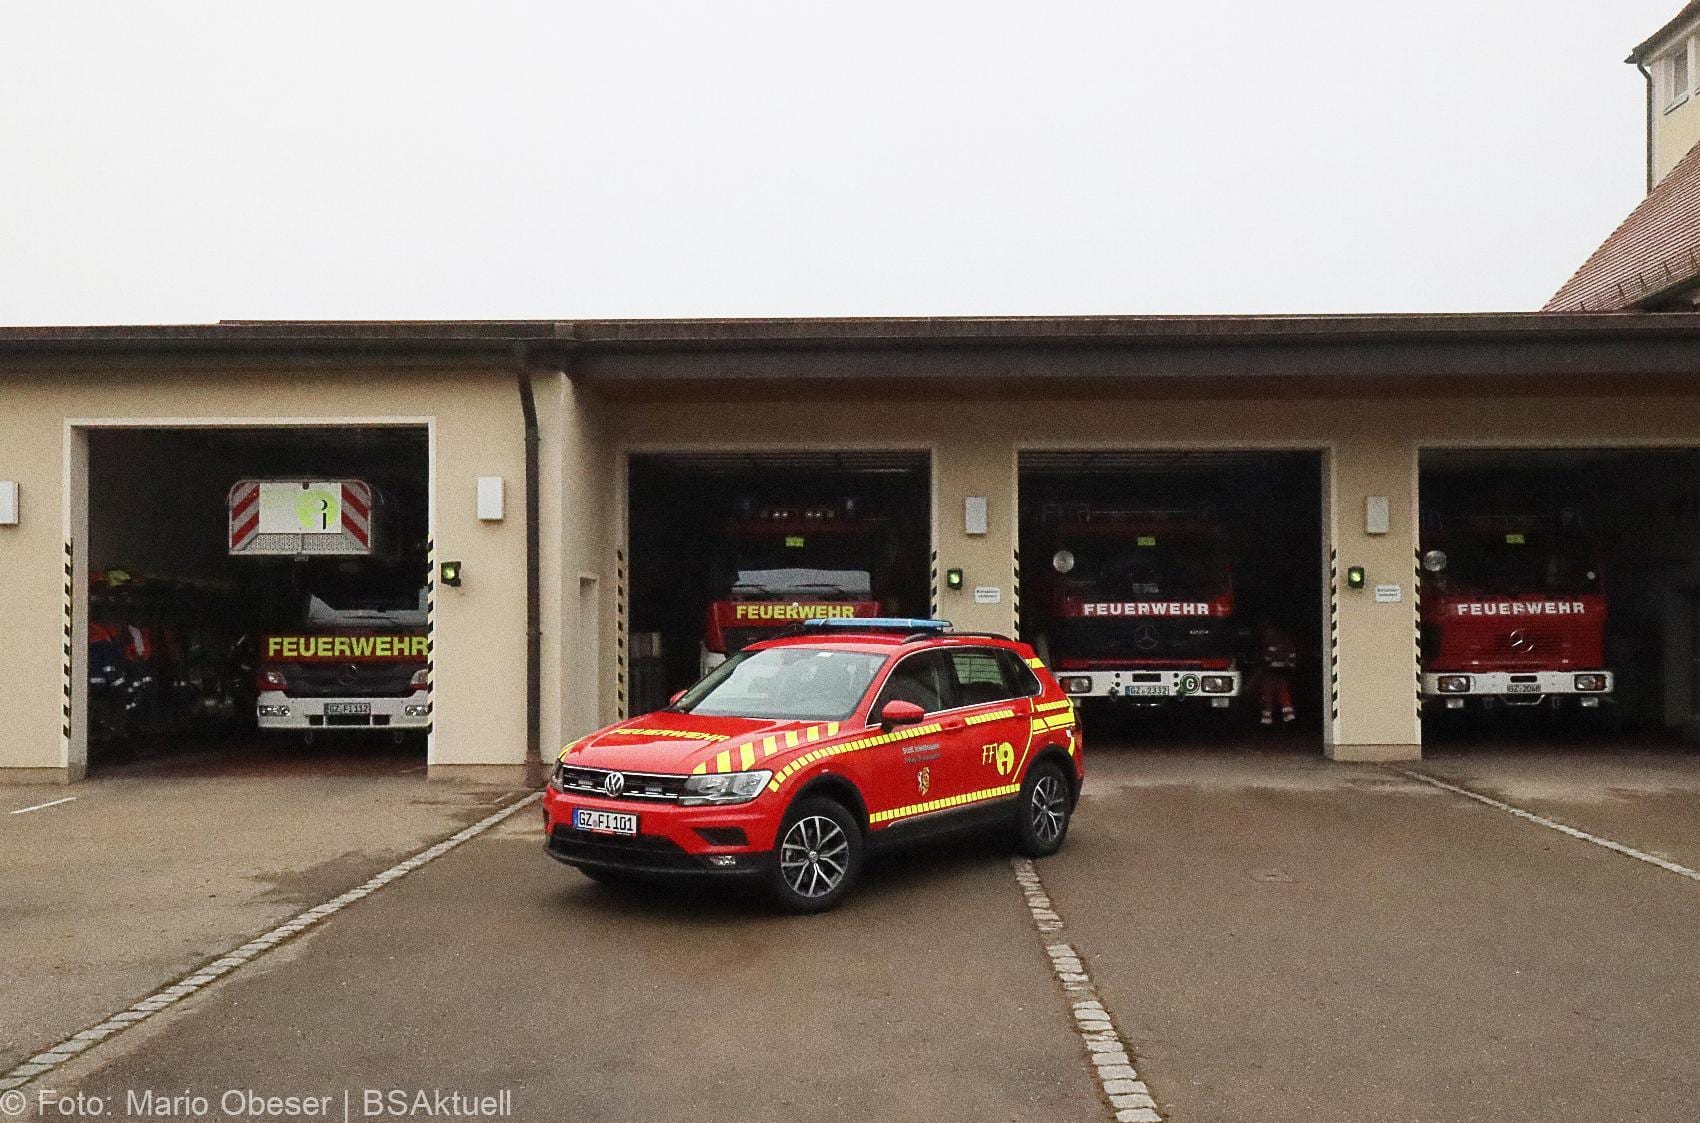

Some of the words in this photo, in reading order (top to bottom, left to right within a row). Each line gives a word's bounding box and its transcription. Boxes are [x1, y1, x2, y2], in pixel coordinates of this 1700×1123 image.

[736, 605, 855, 619] FEUERWEHR
[1084, 602, 1209, 615] FEUERWEHR
[1457, 602, 1585, 615] FEUERWEHR
[268, 637, 428, 656] FEUERWEHR
[1185, 678, 1196, 690] G
[608, 728, 730, 742] FEUERWEHR
[579, 811, 592, 827] GZ
